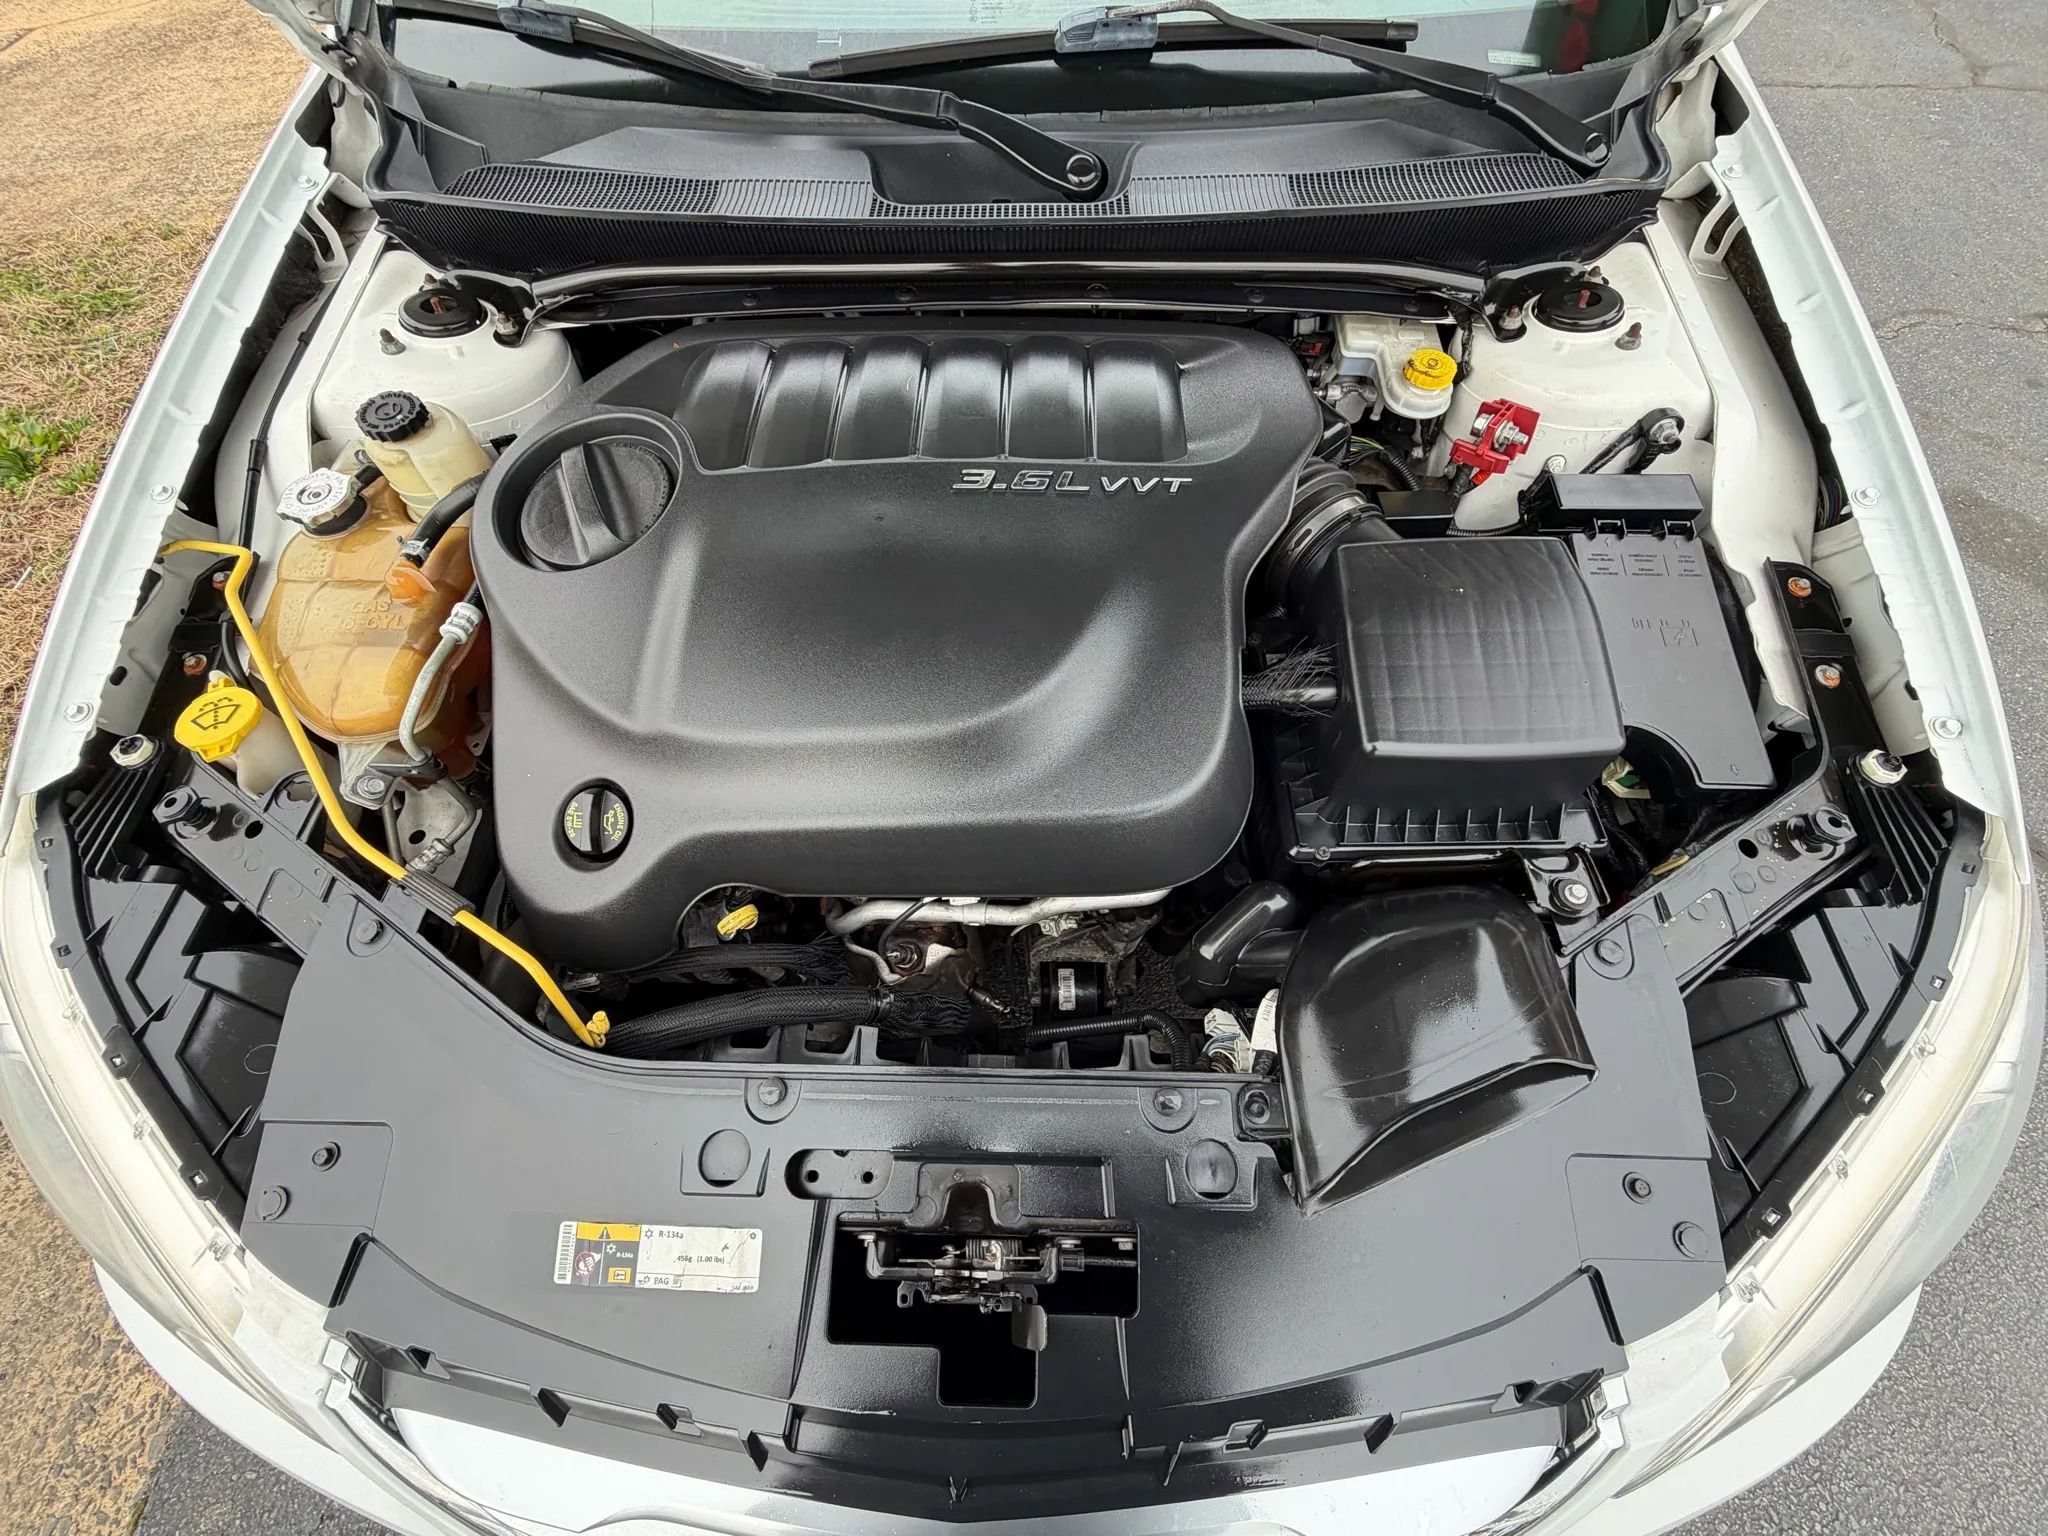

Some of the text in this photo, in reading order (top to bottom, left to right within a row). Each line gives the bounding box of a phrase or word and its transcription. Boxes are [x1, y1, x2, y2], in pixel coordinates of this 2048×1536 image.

[951, 468, 1193, 495] 3.6L VVT
[568, 802, 578, 815] SAE
[610, 803, 624, 841] ENGINE OIL
[658, 1230, 684, 1240] R-134a
[696, 1255, 713, 1264] (1.00
[654, 1277, 670, 1286] PAG
